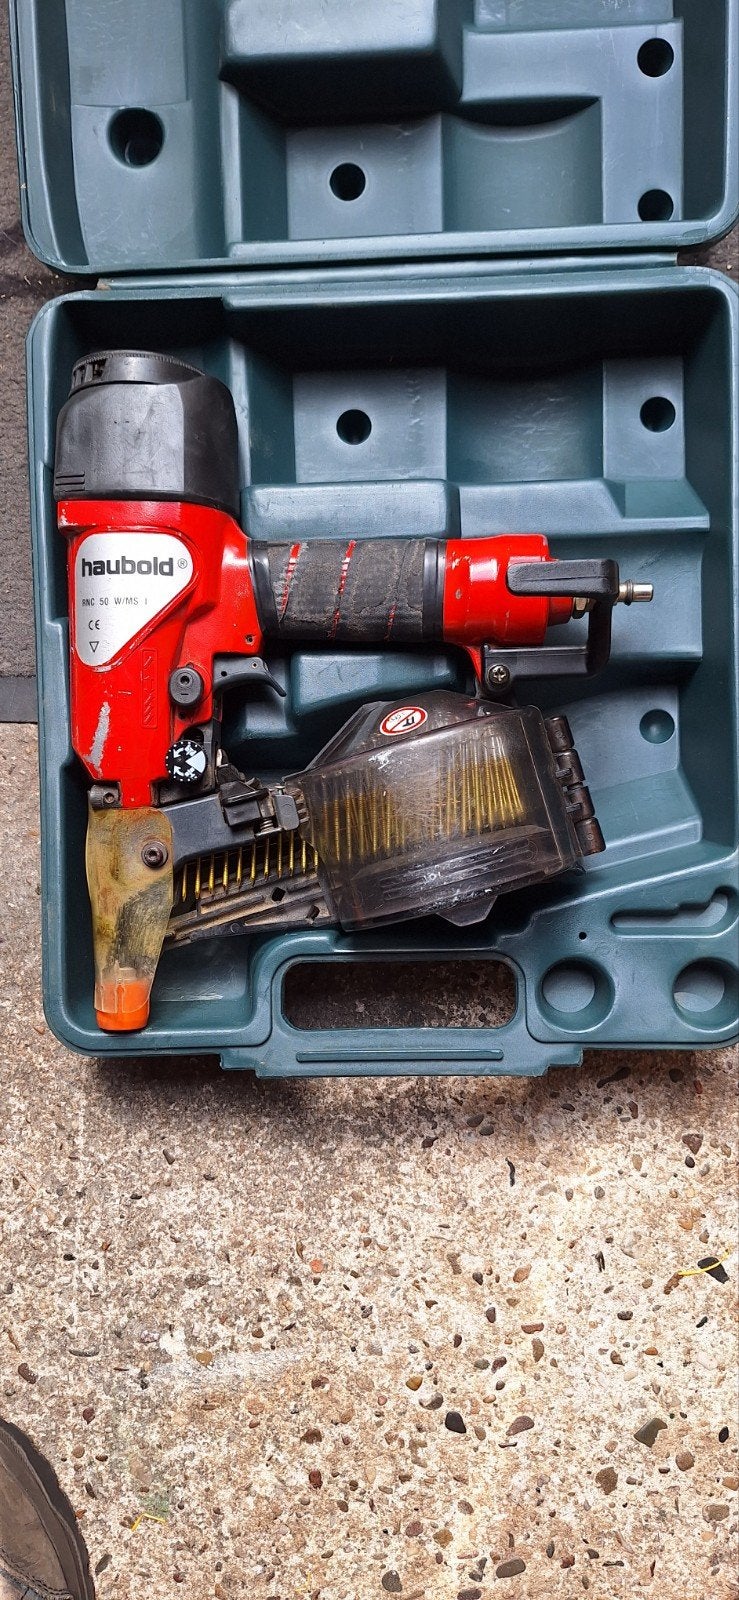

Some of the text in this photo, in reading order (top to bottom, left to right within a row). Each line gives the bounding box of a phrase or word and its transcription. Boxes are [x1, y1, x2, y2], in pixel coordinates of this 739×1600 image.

[81, 555, 174, 577] haubold
[99, 597, 109, 606] 50
[114, 597, 139, 606] W/MS
